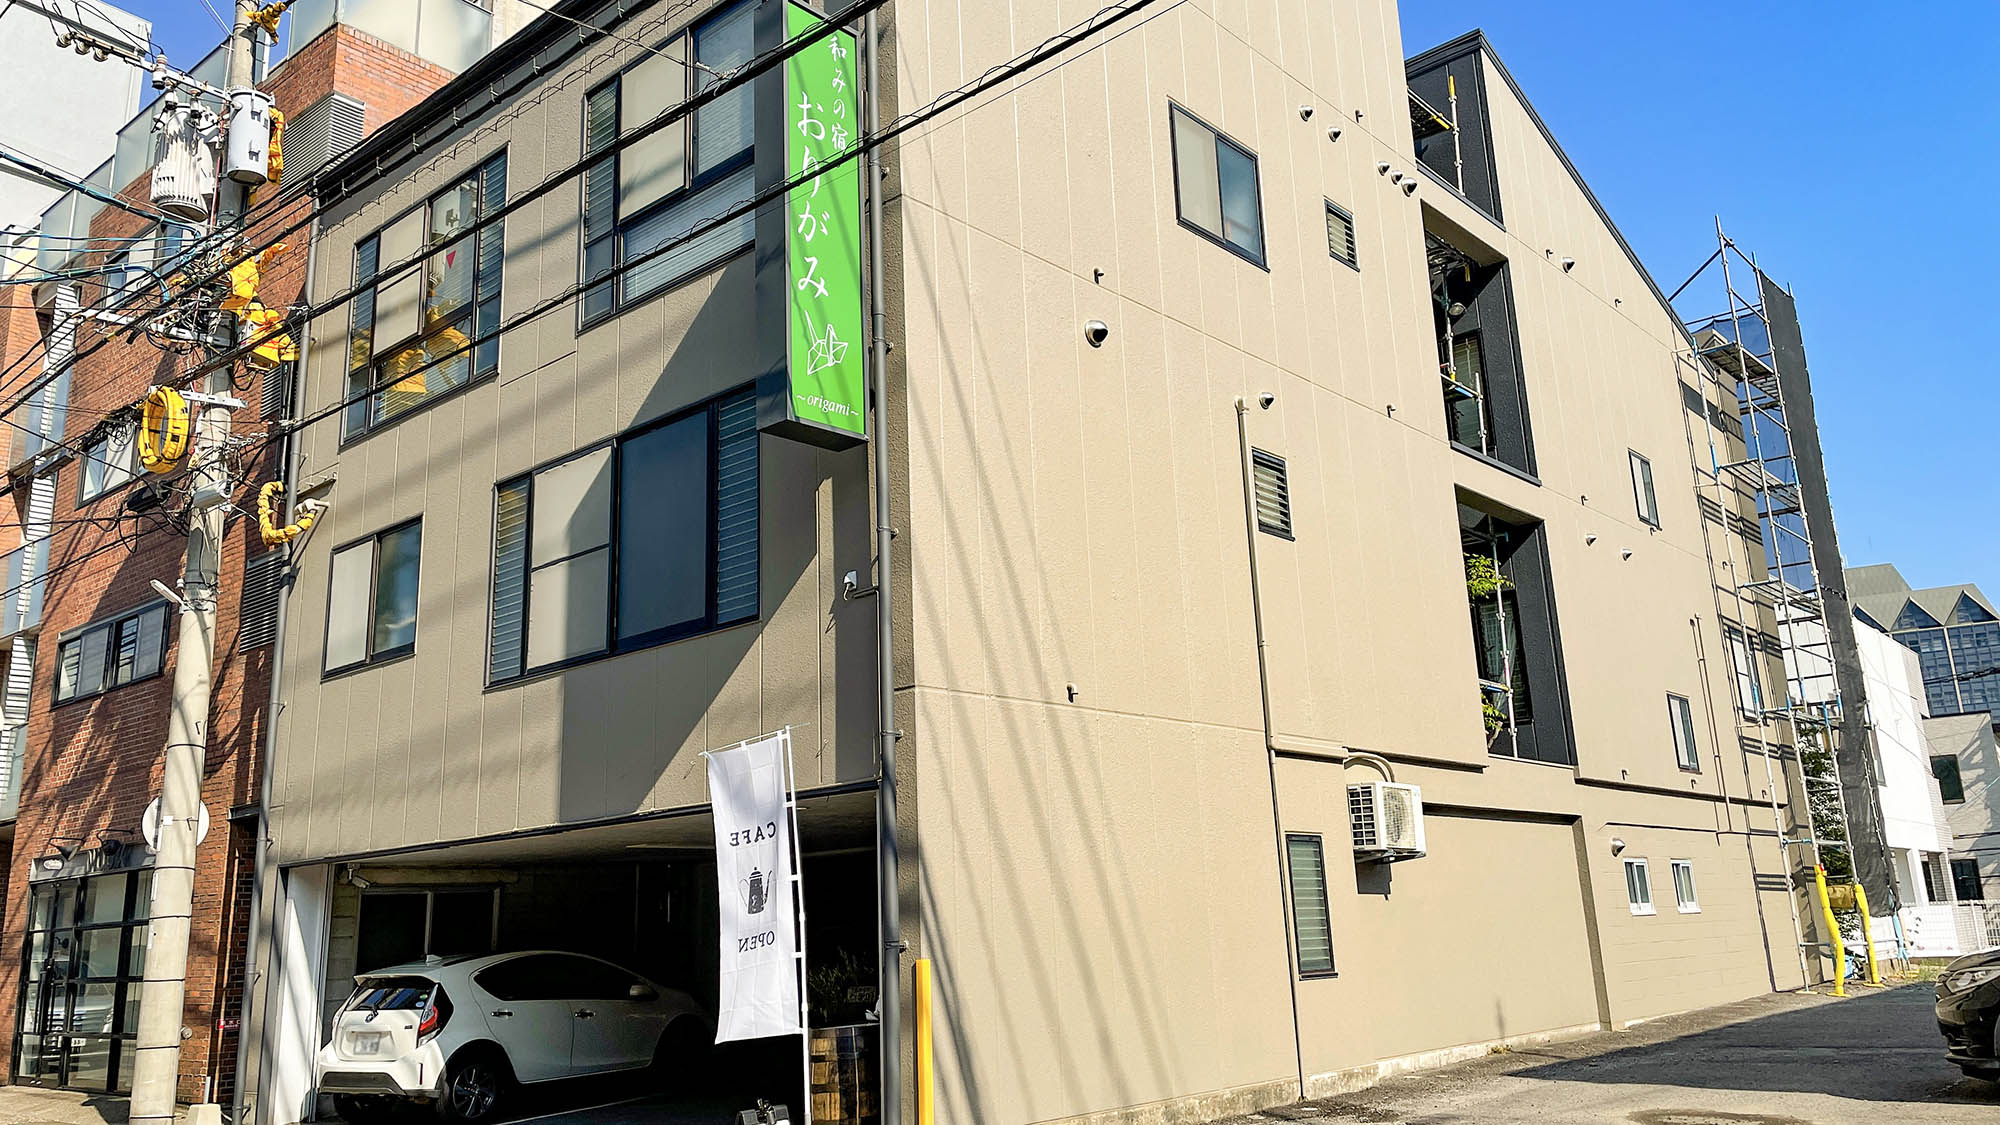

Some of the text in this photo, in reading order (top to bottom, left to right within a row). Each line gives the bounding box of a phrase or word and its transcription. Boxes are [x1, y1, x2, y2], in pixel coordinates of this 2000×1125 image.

[828, 36, 848, 151] 和みの宿
[797, 91, 830, 298] おりがみ
